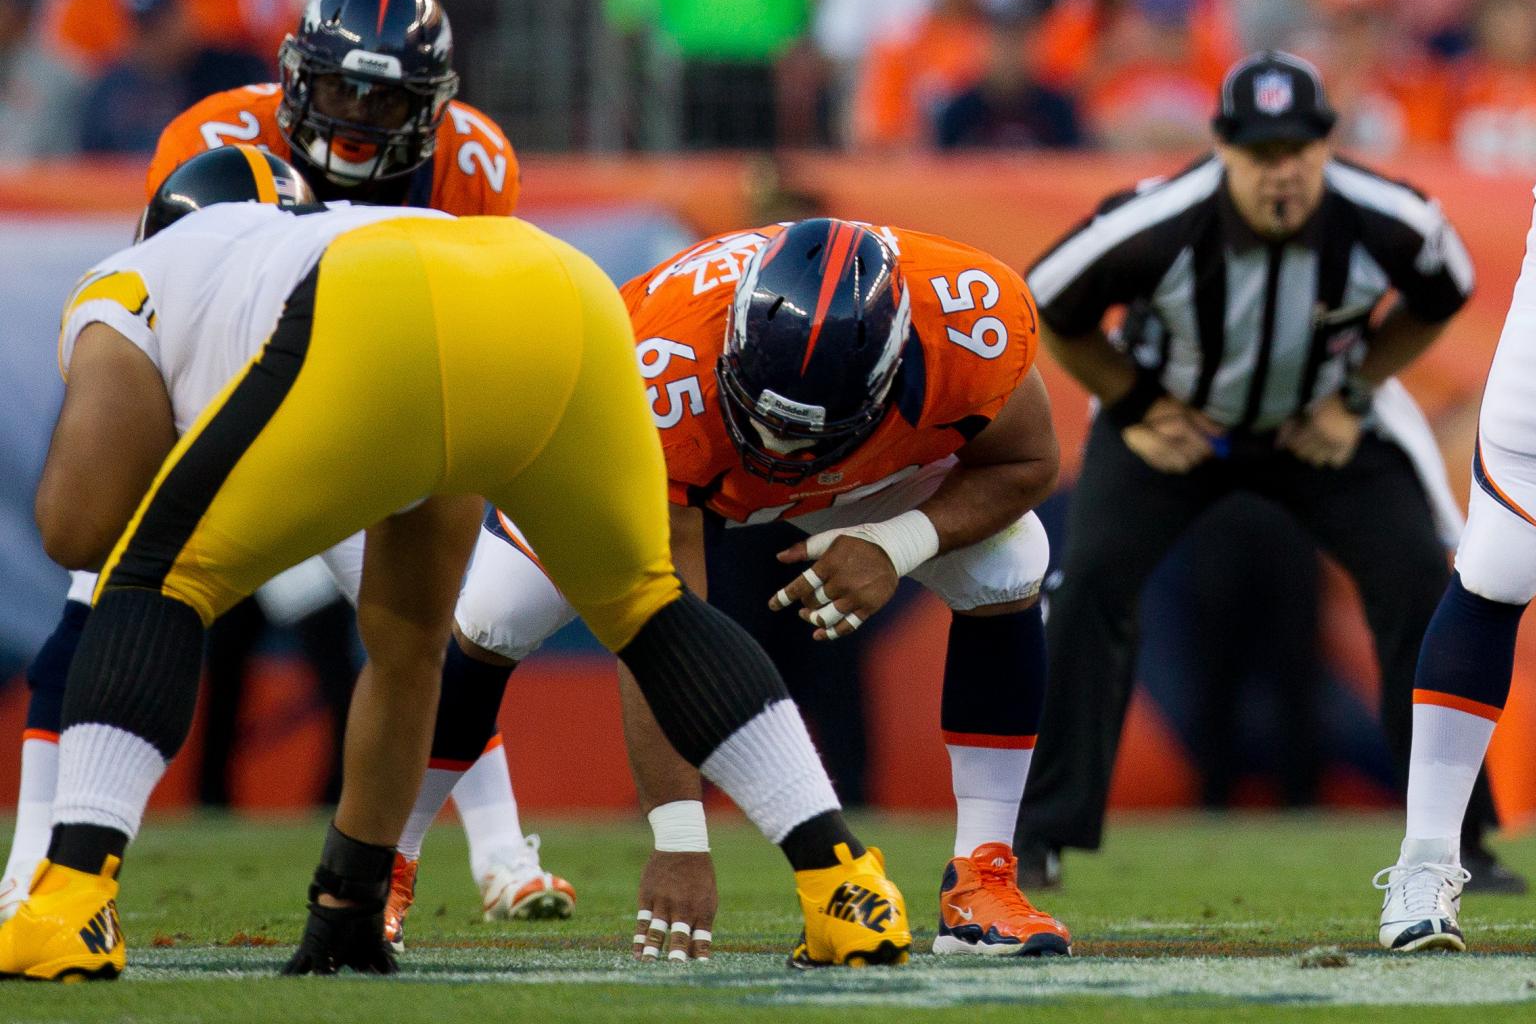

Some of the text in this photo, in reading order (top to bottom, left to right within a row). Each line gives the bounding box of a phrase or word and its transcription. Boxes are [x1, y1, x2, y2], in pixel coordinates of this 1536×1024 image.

[450, 108, 508, 193] 27
[929, 268, 1008, 360] 65
[635, 337, 705, 429] 65
[774, 400, 808, 416] Riddell
